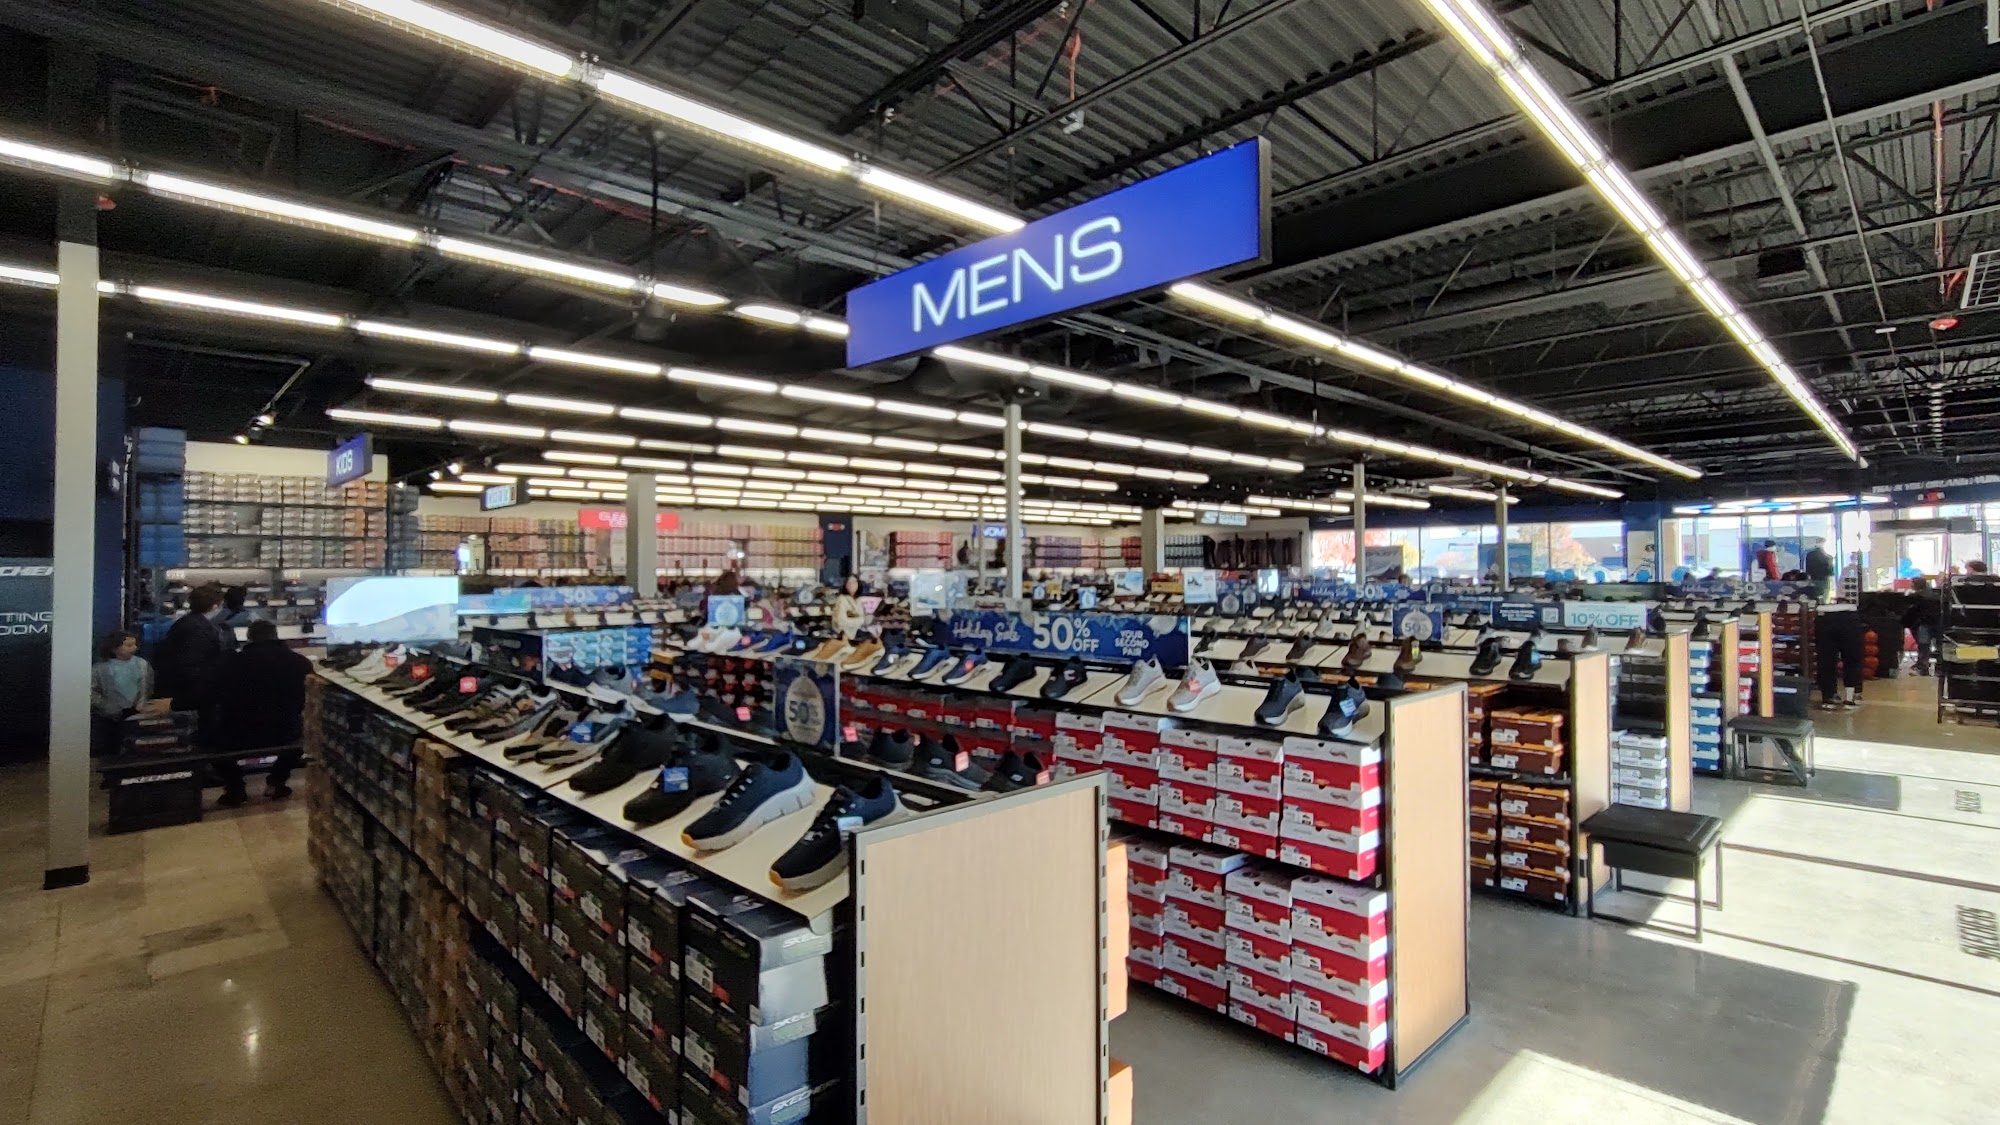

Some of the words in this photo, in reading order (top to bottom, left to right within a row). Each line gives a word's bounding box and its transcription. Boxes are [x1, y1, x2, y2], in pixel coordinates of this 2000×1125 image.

[913, 216, 1123, 333] MENS
[1033, 613, 1091, 651] 50%
[1570, 611, 1603, 625] 10%
[1605, 614, 1640, 627] OFF
[1072, 638, 1100, 653] OFF
